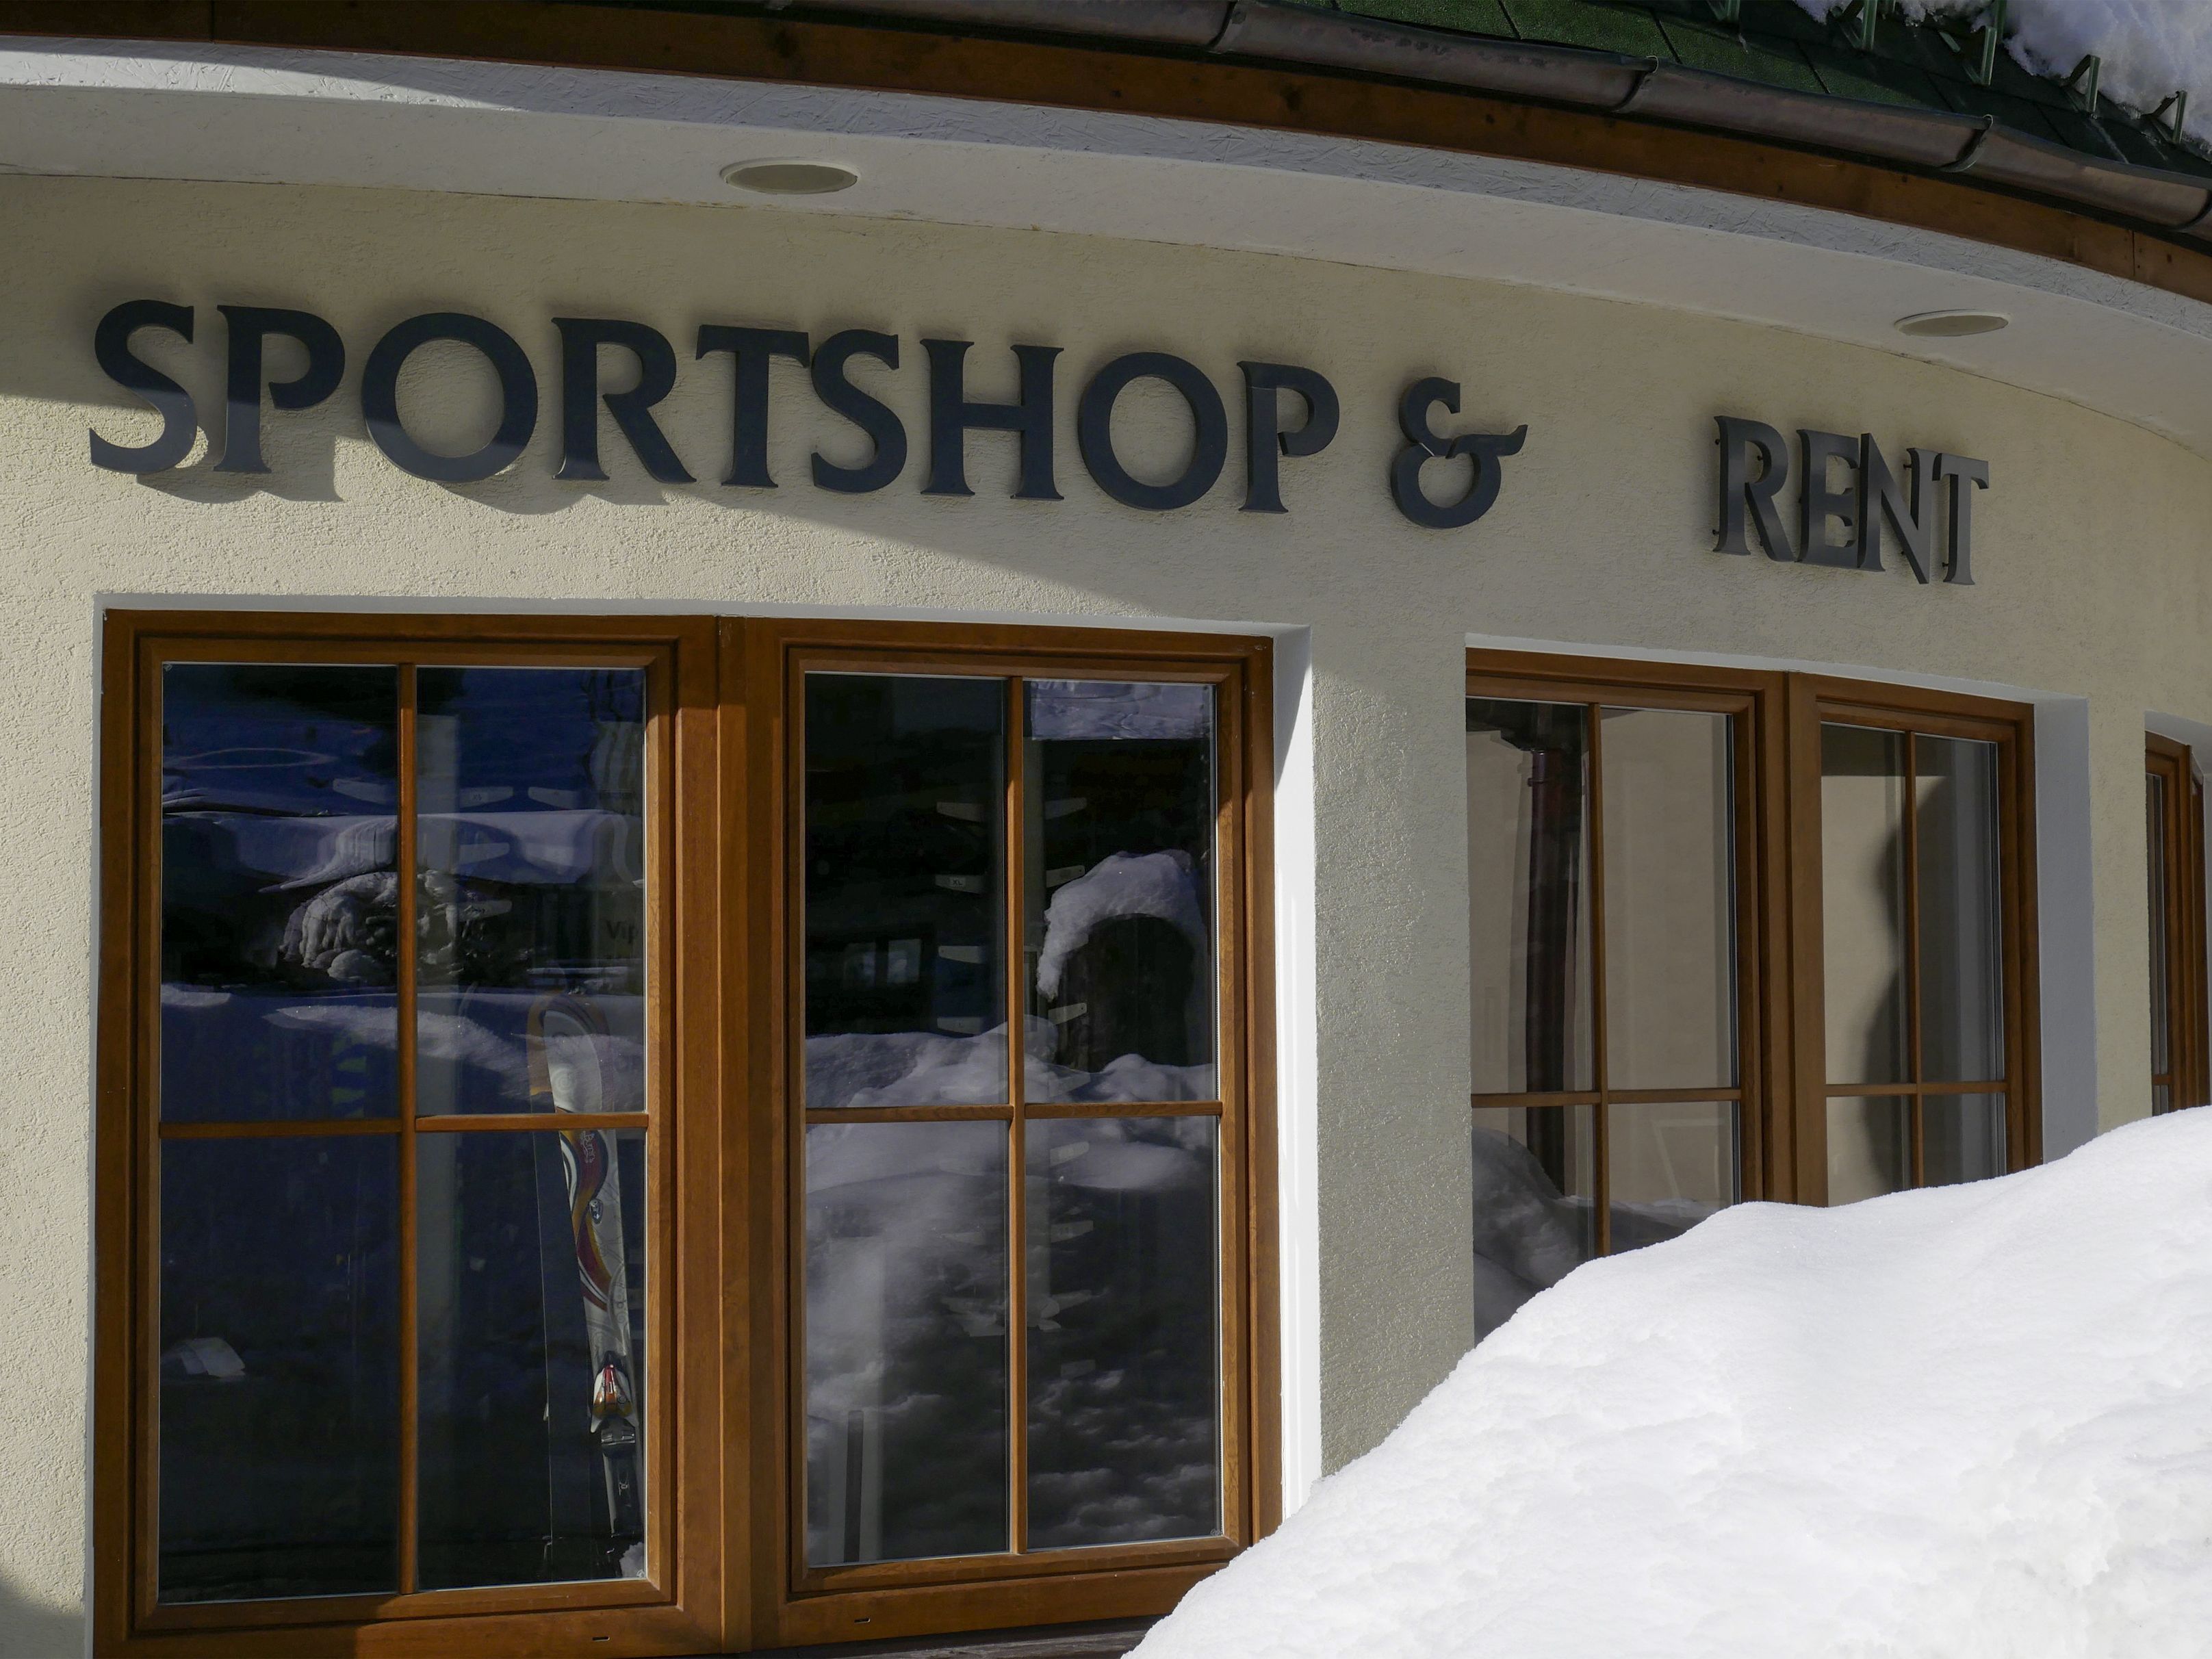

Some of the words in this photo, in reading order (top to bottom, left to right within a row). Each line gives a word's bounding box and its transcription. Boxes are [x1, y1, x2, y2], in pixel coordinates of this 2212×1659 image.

[89, 299, 1340, 513] SPORTSHOP
[1390, 376, 1528, 530] &
[1712, 415, 1990, 586] RENT
